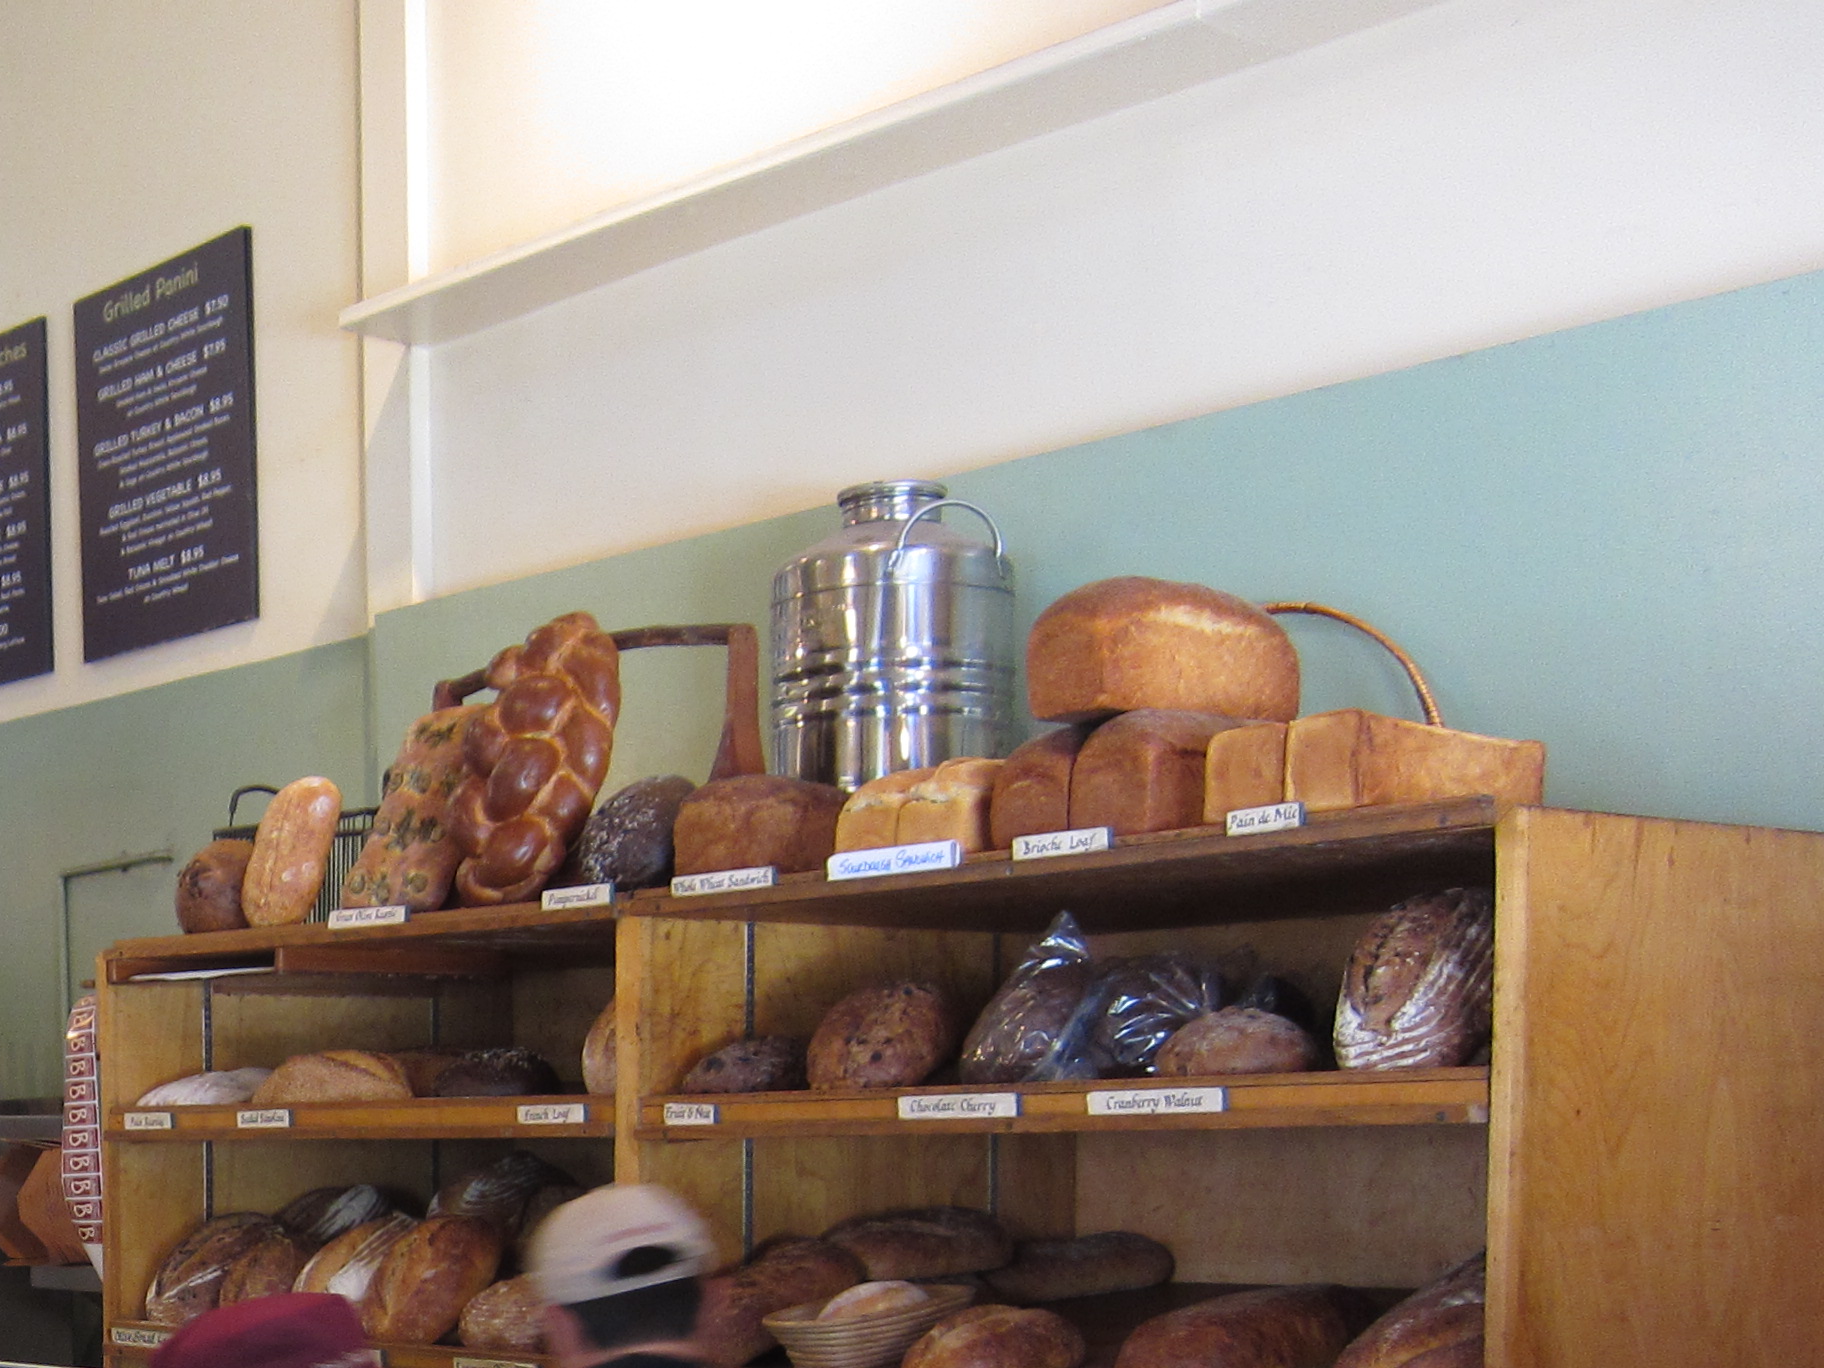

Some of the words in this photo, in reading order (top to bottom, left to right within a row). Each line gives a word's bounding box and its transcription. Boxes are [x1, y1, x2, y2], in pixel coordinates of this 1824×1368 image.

[103, 285, 151, 323] Grilled
[156, 261, 199, 299] Panini
[167, 306, 200, 331] CHEESE
[165, 350, 198, 375] CHEESE
[145, 478, 193, 506] VEGETABLE
[152, 554, 175, 572] MELT
[1230, 813, 1256, 829] Pain
[1258, 812, 1273, 827] de
[1022, 836, 1062, 855] Brioche
[838, 855, 892, 875] SOURDOUGH
[727, 868, 772, 889] Sandwich
[910, 1099, 956, 1113] Chocolate
[960, 1099, 996, 1116] Cherry
[1106, 1096, 1160, 1114] Cranberry
[1163, 1094, 1204, 1108] Walnut
[524, 1107, 549, 1122] French
